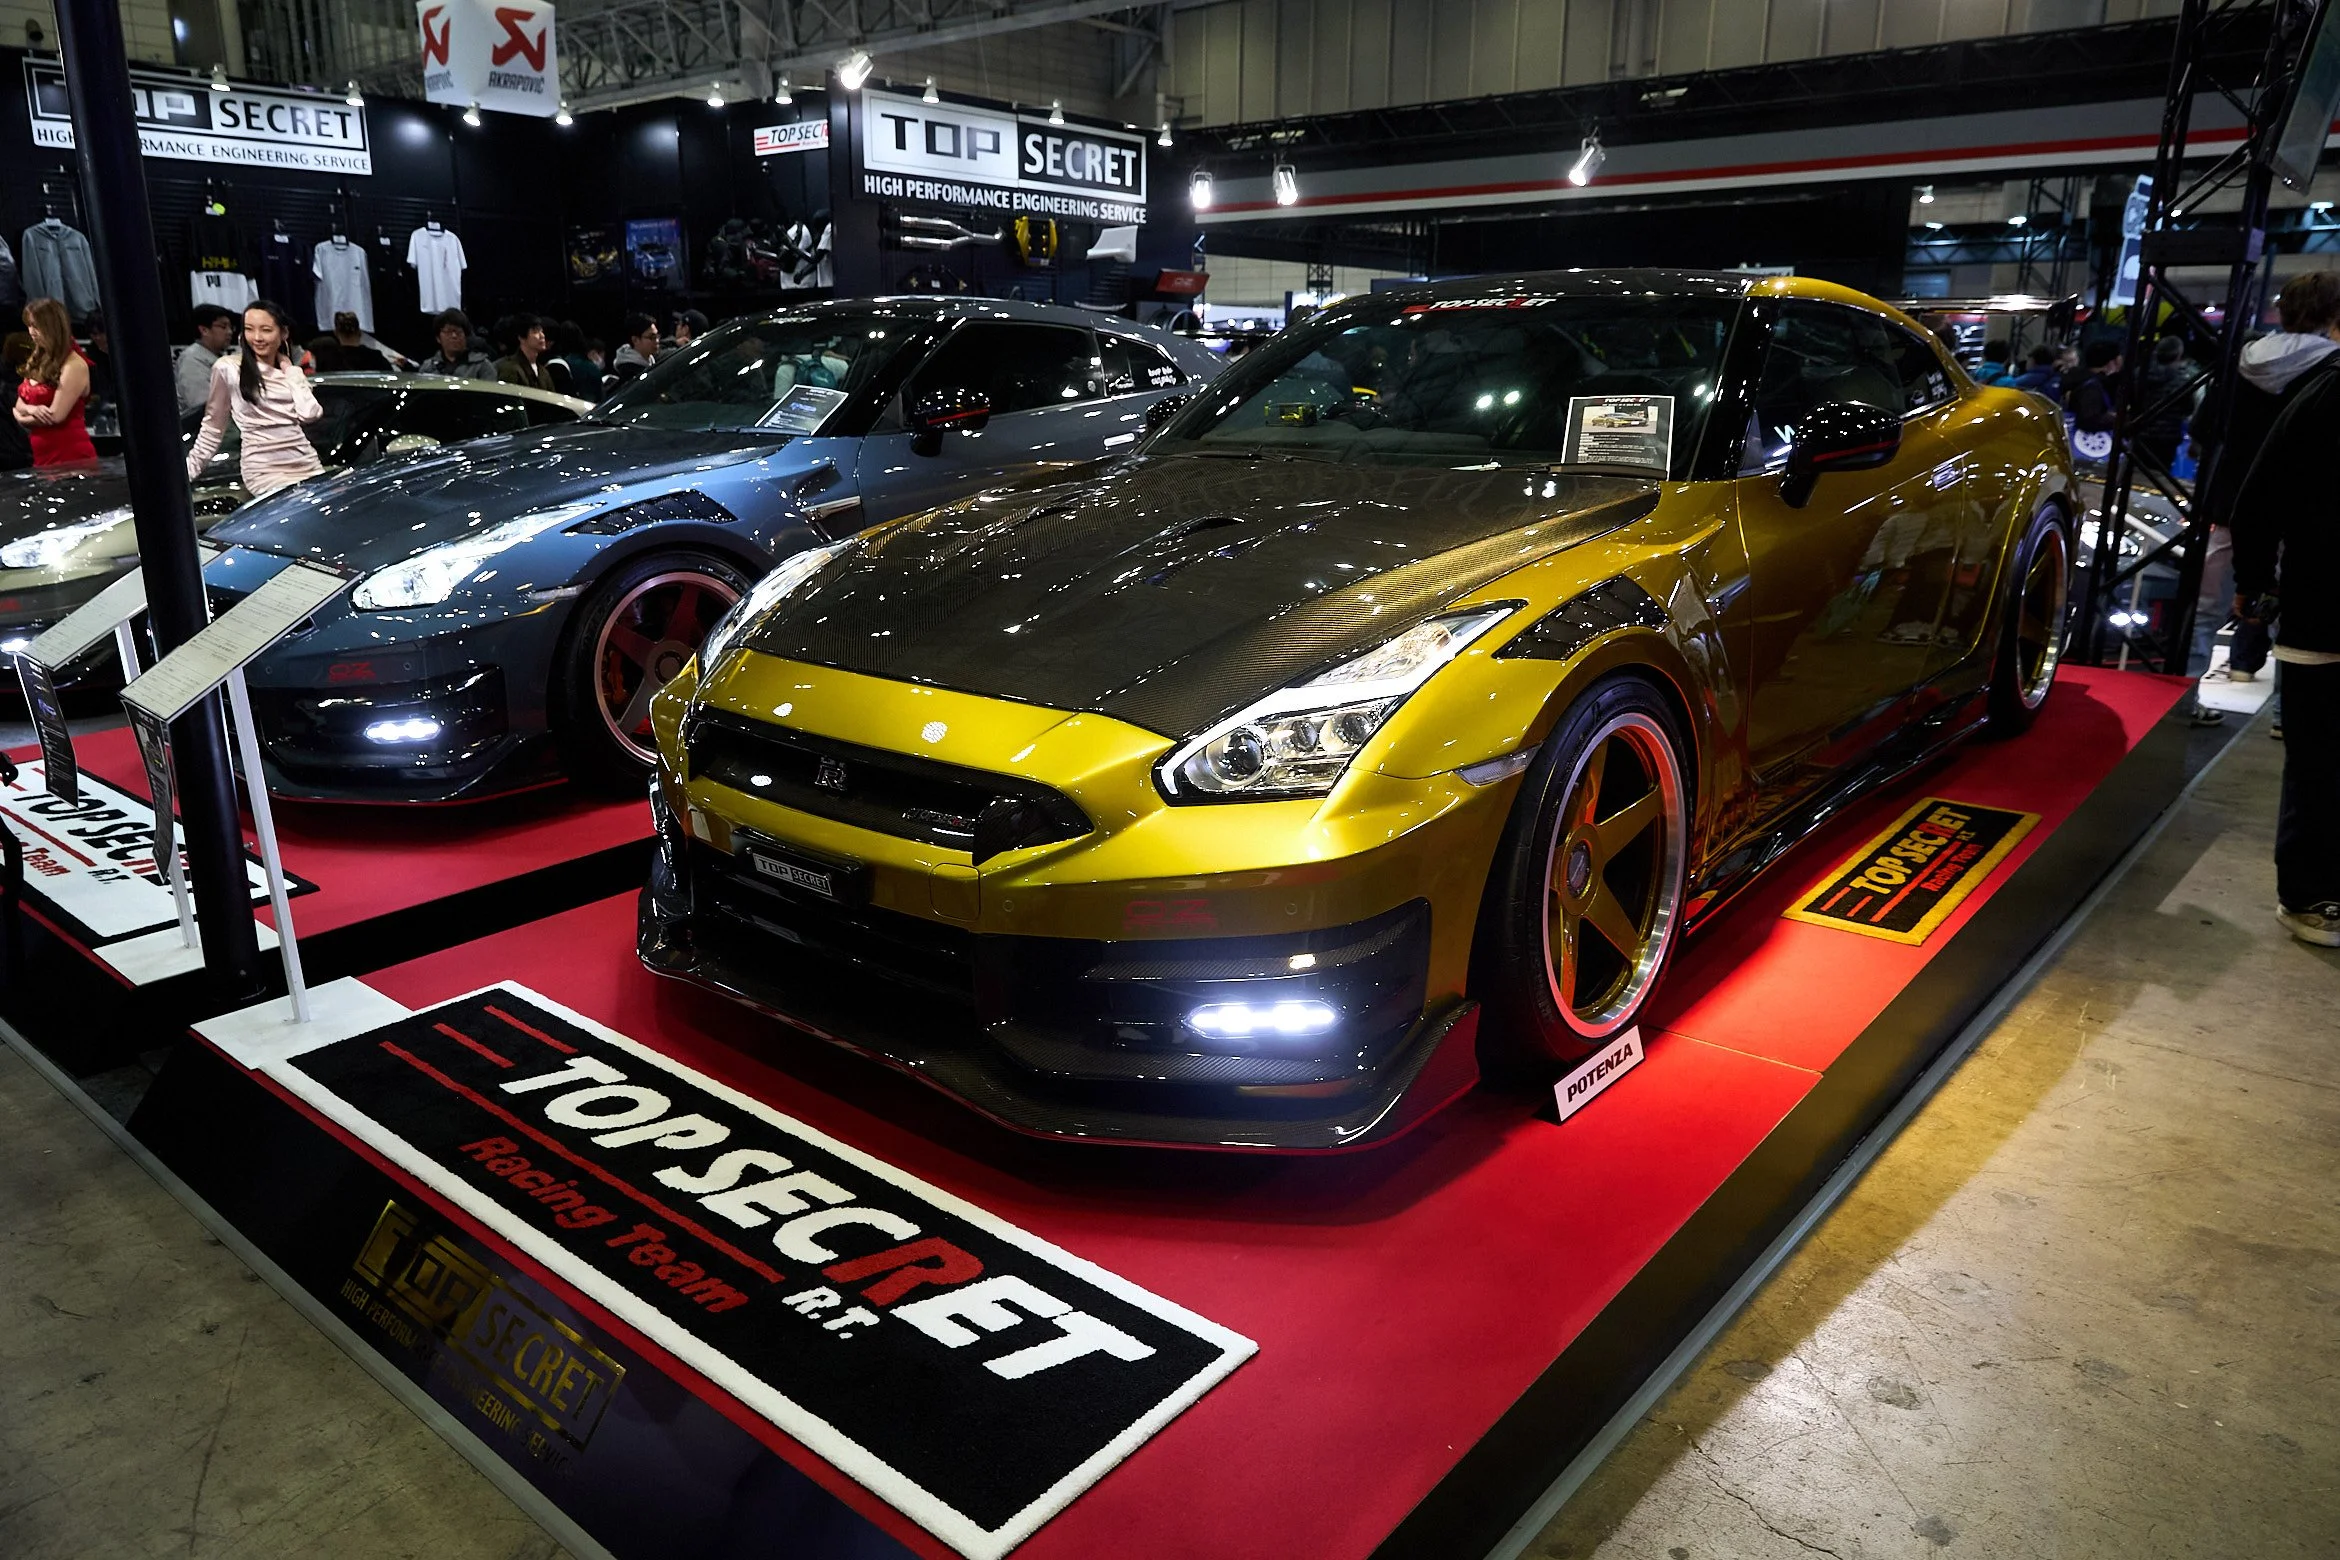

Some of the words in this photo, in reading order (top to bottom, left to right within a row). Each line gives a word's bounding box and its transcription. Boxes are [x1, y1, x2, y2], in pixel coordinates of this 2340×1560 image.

[219, 99, 352, 140] SECRET
[211, 145, 309, 166] ENGINEERING
[313, 154, 368, 171] SERVICE
[880, 112, 1000, 161] TOP
[1023, 133, 1139, 188] SECRET
[864, 174, 903, 198] HIGH
[906, 179, 1011, 210] PERFORMANCE
[1013, 192, 1099, 219] ENGINEERING
[1099, 203, 1147, 225] SERVICE
[758, 858, 789, 876] TOP
[792, 869, 827, 889] SECRET
[1567, 1042, 1633, 1103] POTENZA
[459, 1136, 619, 1231] Racing
[606, 1222, 750, 1315] Team
[340, 1278, 371, 1313] HIGH
[782, 1285, 880, 1340] R.T.
[475, 1303, 605, 1421] SECRET
